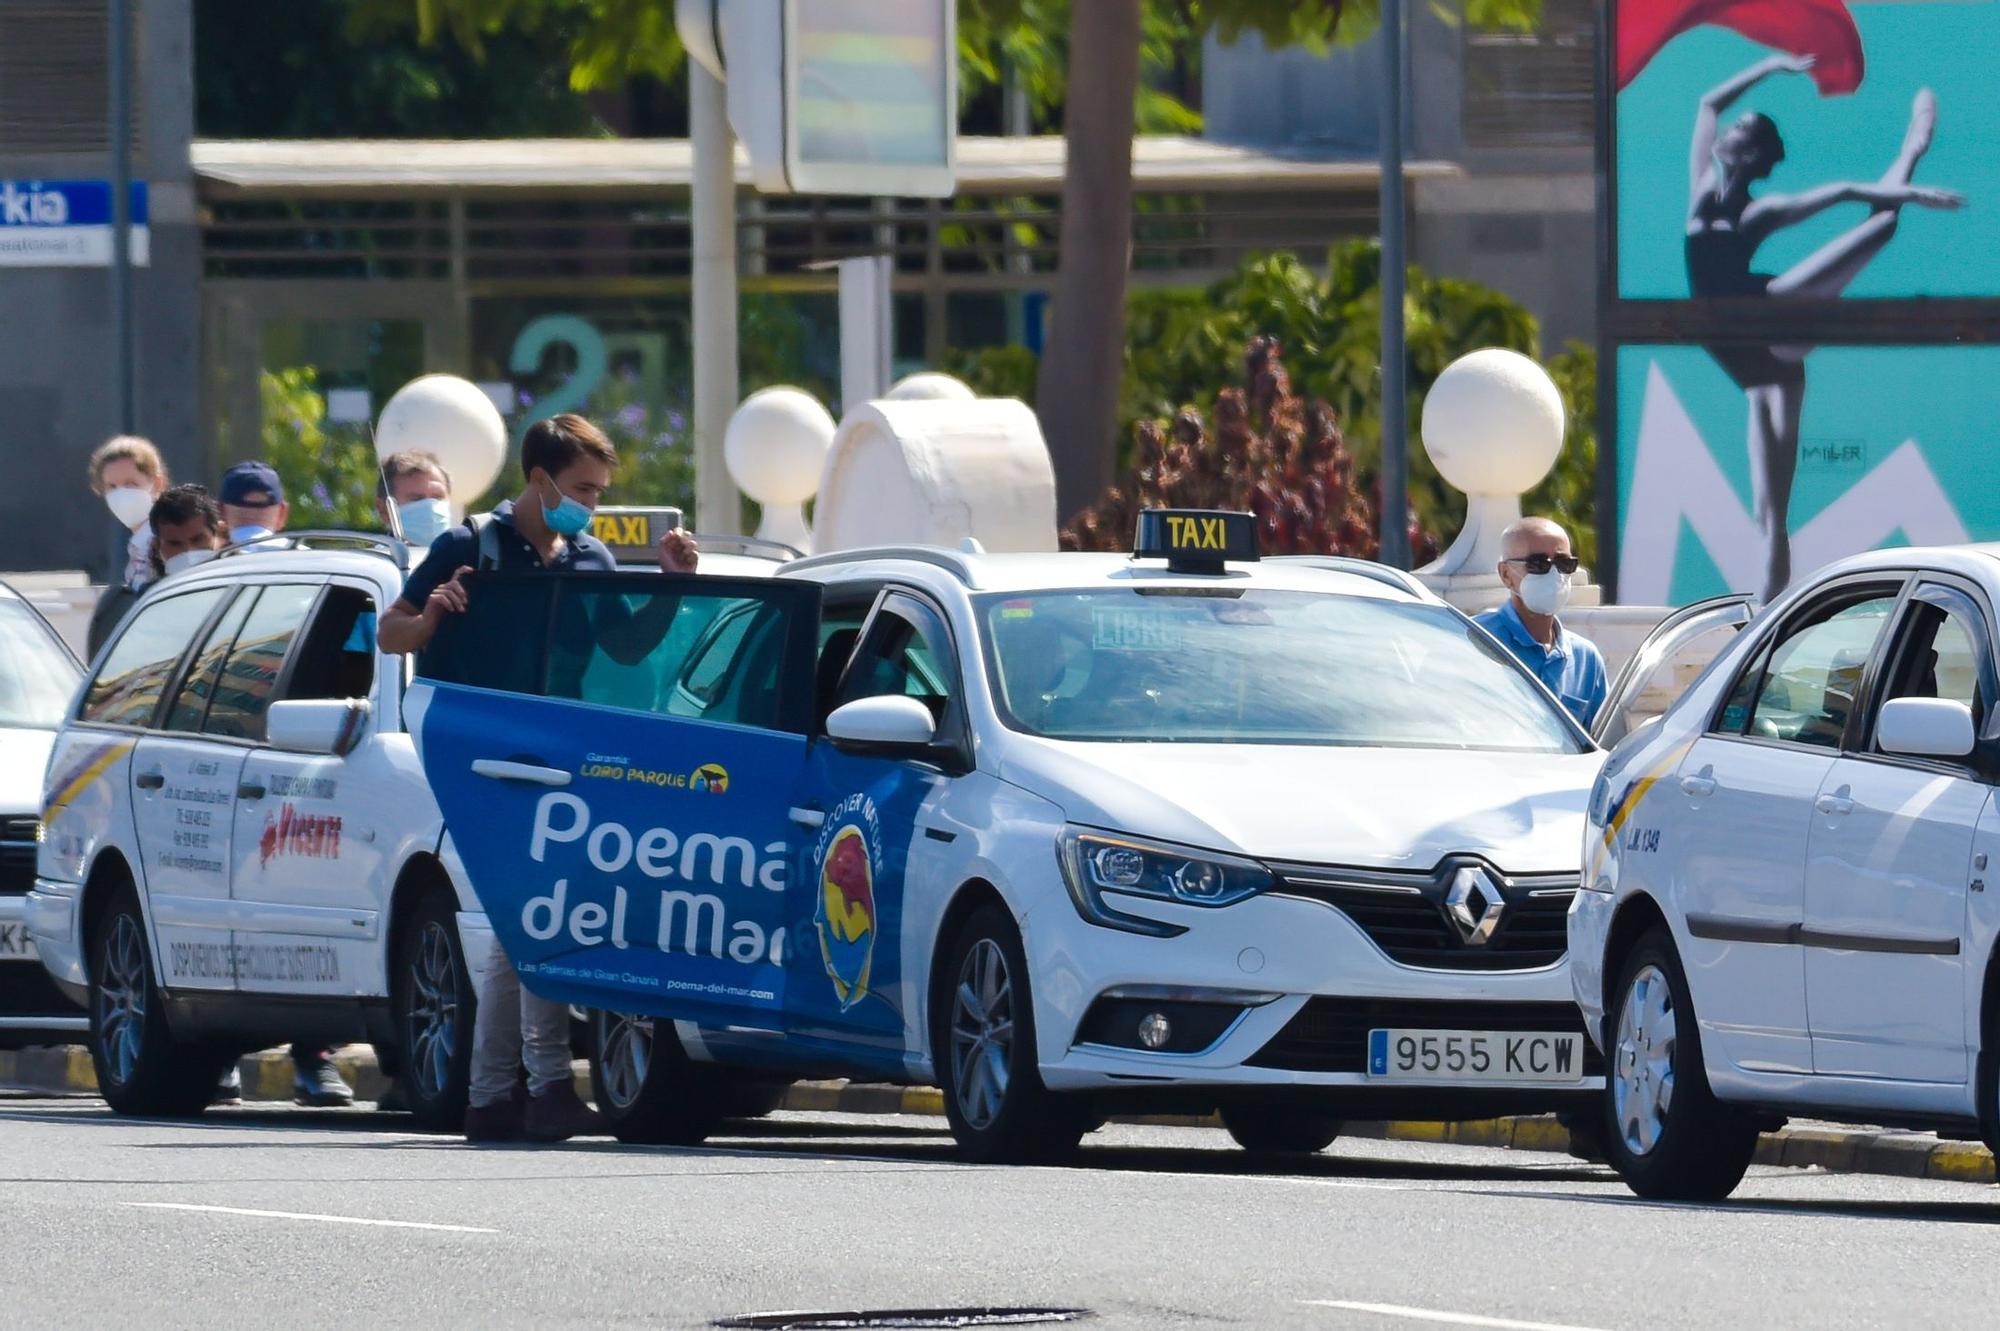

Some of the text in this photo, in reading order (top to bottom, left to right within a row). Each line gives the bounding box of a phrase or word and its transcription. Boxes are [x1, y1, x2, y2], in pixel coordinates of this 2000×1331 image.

[593, 515, 649, 545] TAXI
[1166, 516, 1227, 549] TAXI
[580, 764, 687, 788] LORO PARQUE
[529, 791, 787, 892] Poema
[813, 792, 864, 866] DISCOVER
[521, 878, 630, 950] del
[517, 961, 775, 1000] Las Palmas de Gran Canaria poema-del-mar.com
[1375, 1036, 1574, 1074] E 9555 KCW
